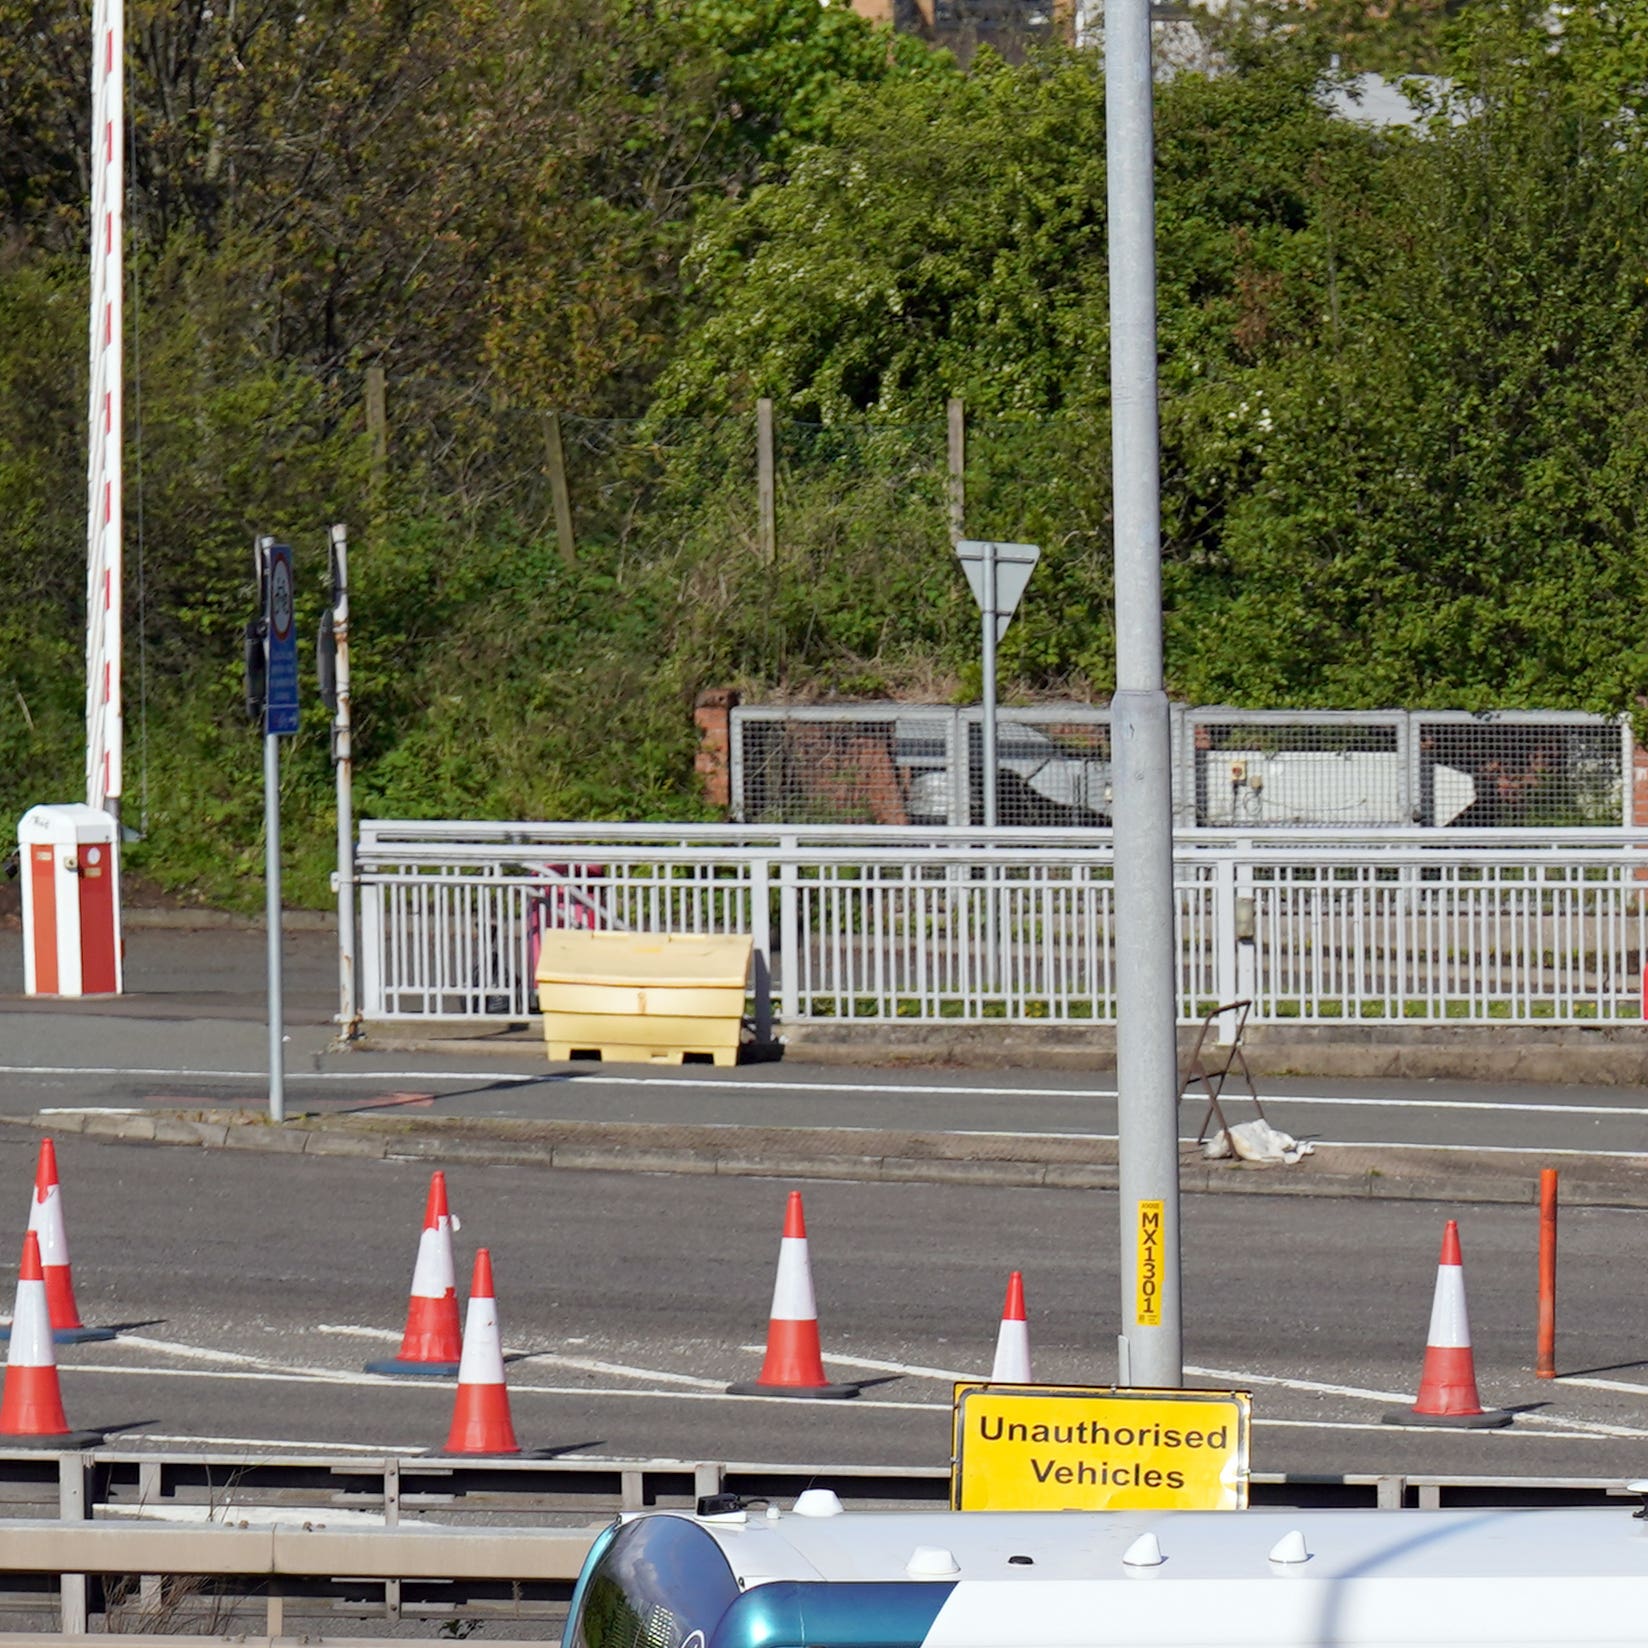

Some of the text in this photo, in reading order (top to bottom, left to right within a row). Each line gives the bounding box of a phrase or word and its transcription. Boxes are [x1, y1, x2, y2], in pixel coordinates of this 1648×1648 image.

[1142, 1212, 1159, 1314] MX1301
[980, 1416, 1227, 1449] Unauthorised
[1031, 1459, 1184, 1488] Vehicles
